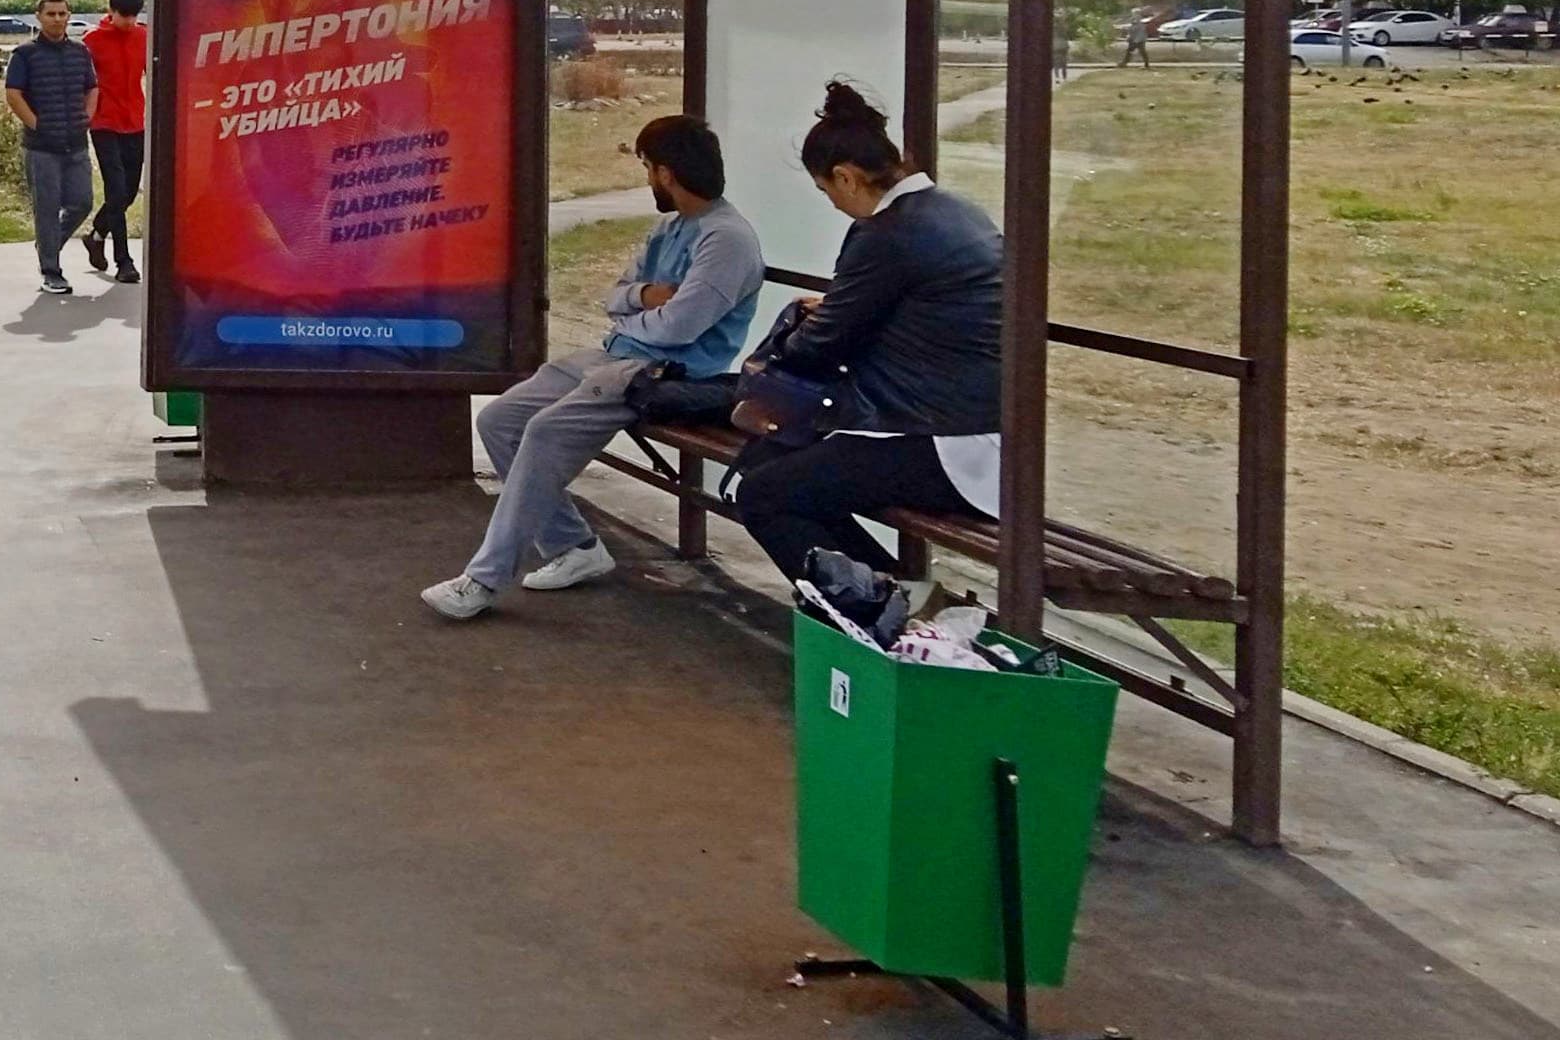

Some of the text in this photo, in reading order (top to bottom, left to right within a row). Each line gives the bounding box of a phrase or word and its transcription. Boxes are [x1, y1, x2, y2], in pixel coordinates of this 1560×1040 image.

[220, 79, 277, 110] ЭТО
[284, 52, 406, 97] «ТИХИЙ
[218, 96, 363, 140] УБИЙЦА»
[331, 129, 450, 164] РЕГУЛЯРНО
[330, 157, 452, 191] ИЗМЕРЯЙТЕ
[328, 185, 446, 221] ДАВЛЕНИЕ.
[329, 204, 490, 244] БУДЬТЕ НАЧЕКУ
[280, 321, 394, 338] takzdorovo.ru
